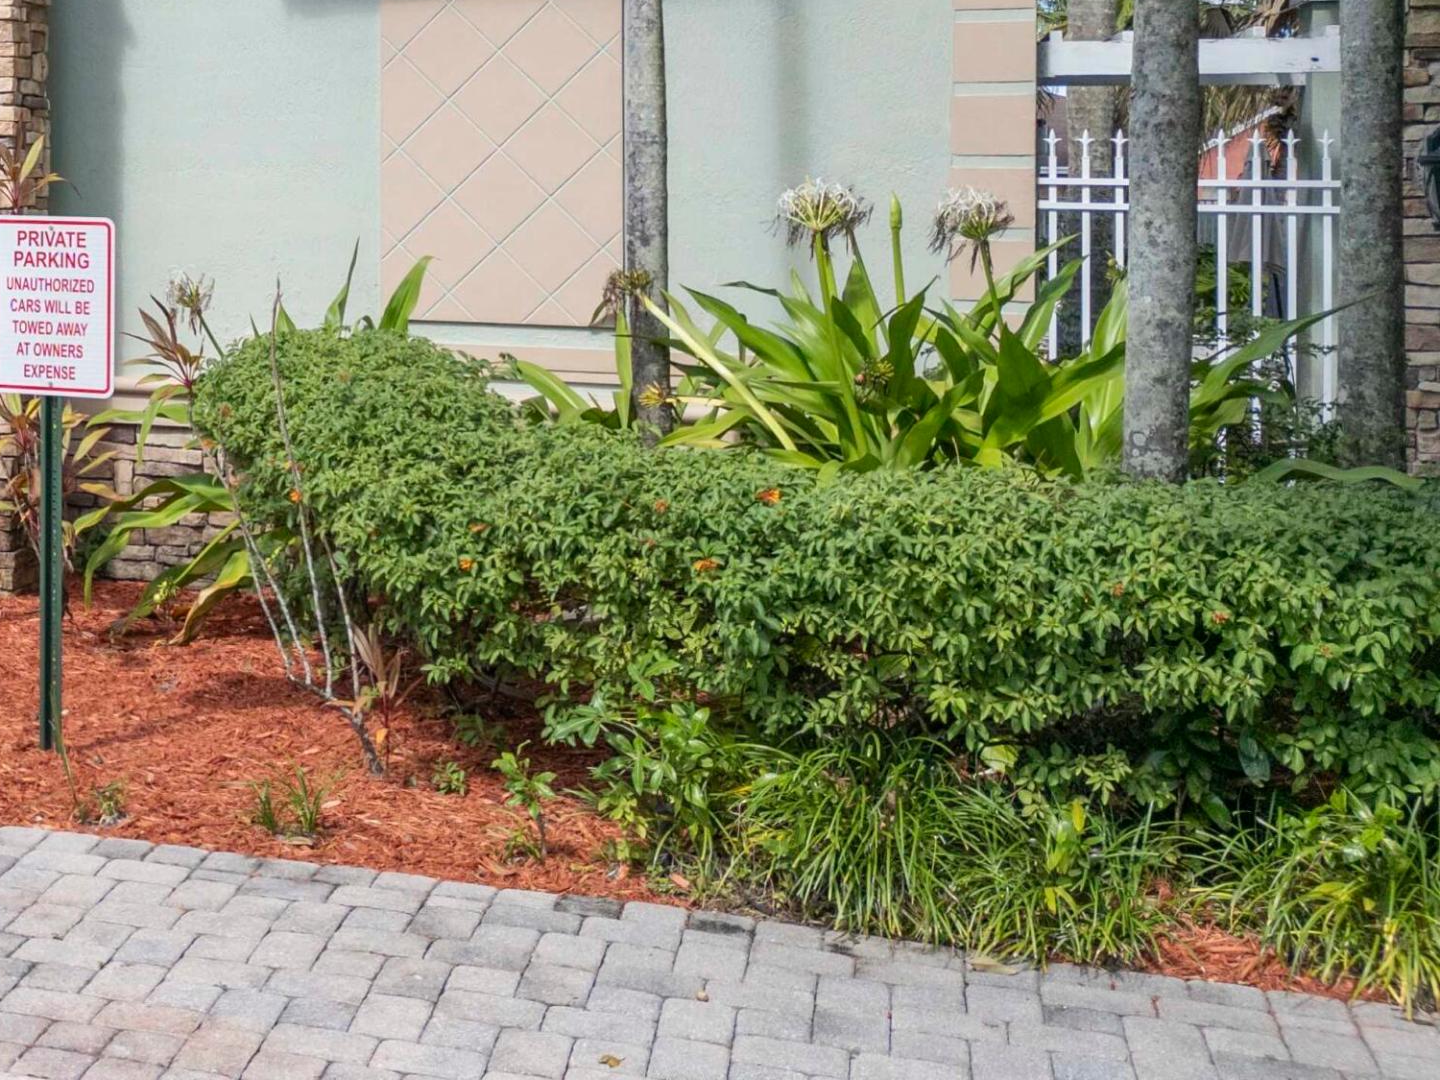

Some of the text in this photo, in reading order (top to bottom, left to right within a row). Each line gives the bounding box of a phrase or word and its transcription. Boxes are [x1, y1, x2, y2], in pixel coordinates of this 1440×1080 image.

[17, 230, 86, 248] PRIVATE
[14, 251, 90, 269] PARKING
[6, 276, 95, 293] UNAUTHORIZED
[10, 298, 90, 315] CARS WILL BE
[13, 320, 88, 336] TOWED AWAY
[16, 342, 83, 358] AT OWNERS
[24, 364, 76, 380] EXPENSE
